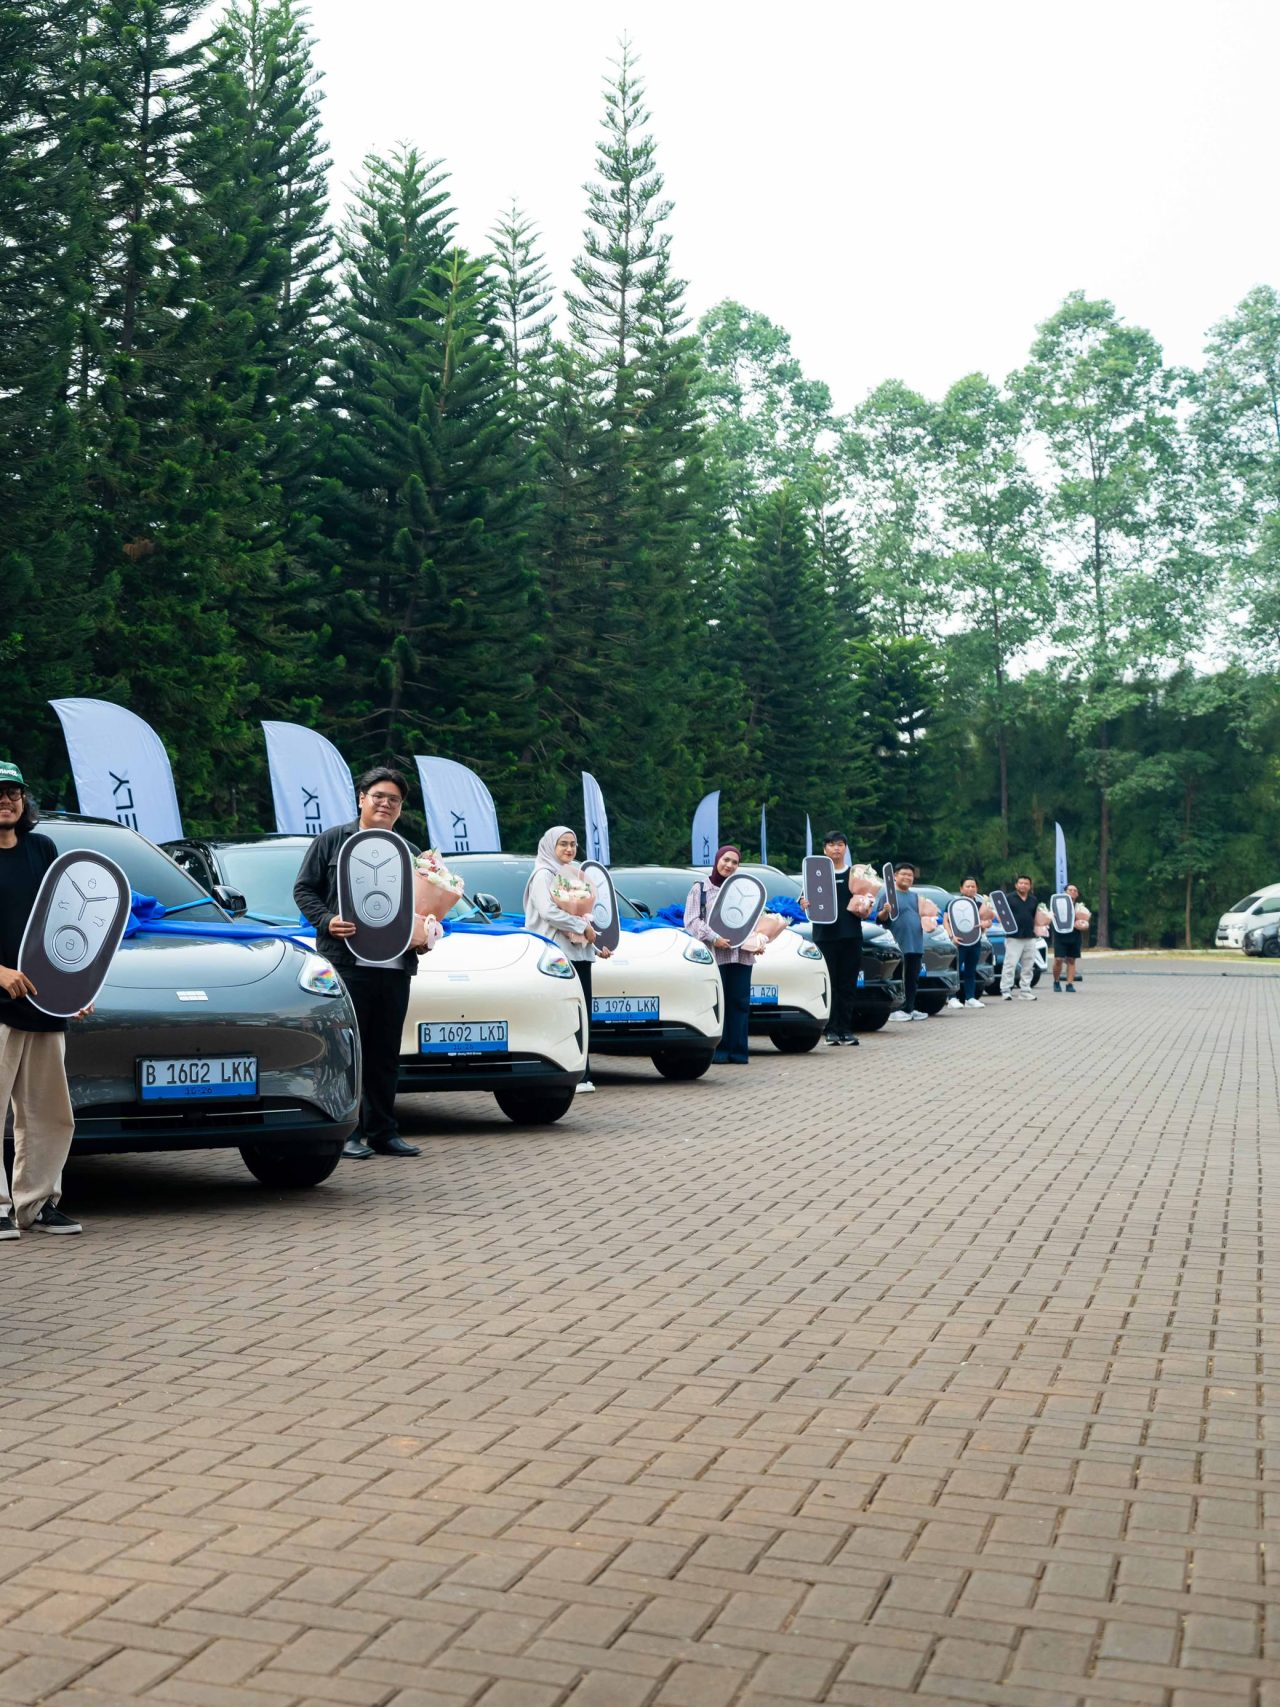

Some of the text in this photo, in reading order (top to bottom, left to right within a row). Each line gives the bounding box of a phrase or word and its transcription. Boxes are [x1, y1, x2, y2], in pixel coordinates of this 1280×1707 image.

[593, 999, 657, 1013] B 1976 LKK
[423, 1025, 505, 1043] B 1692 LKD
[146, 1061, 254, 1085] B 1602 LKK
